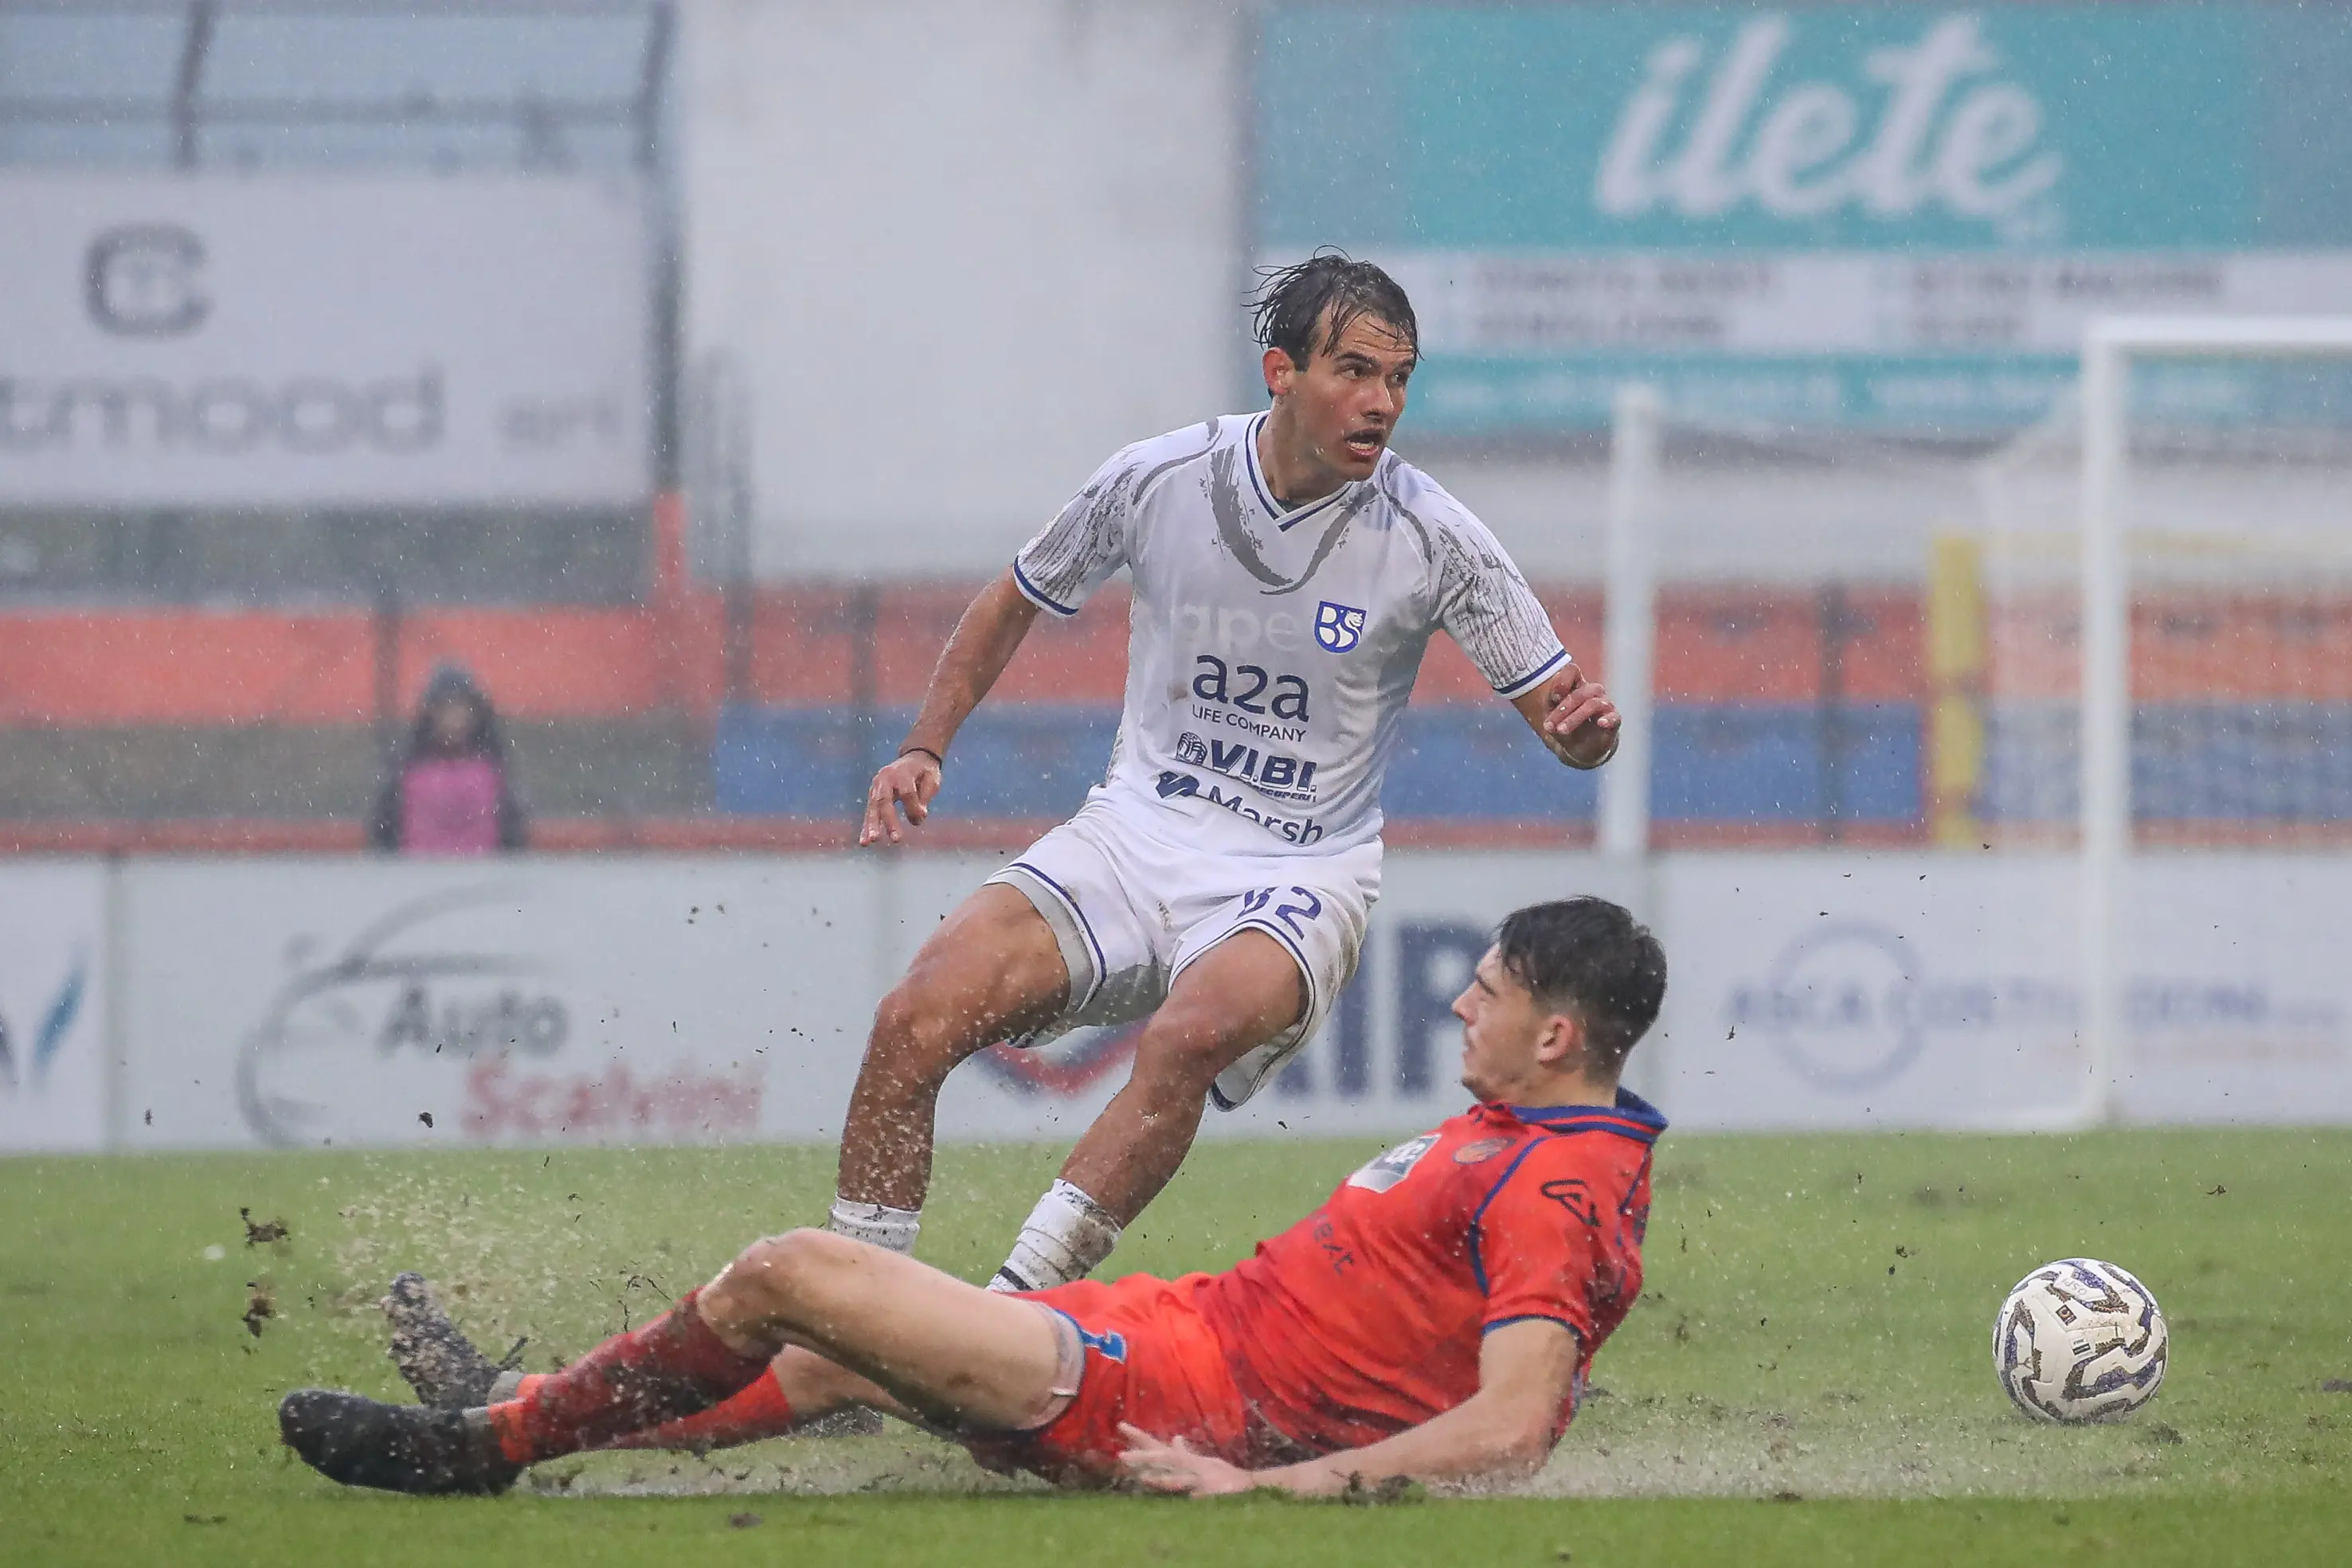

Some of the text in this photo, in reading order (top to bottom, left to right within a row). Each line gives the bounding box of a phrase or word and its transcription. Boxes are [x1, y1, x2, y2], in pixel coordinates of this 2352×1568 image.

[1597, 14, 2061, 213] ilete
[1192, 655, 1309, 722] a2a
[1192, 704, 1307, 742] LIFE COMPANY
[378, 983, 570, 1058] Auto
